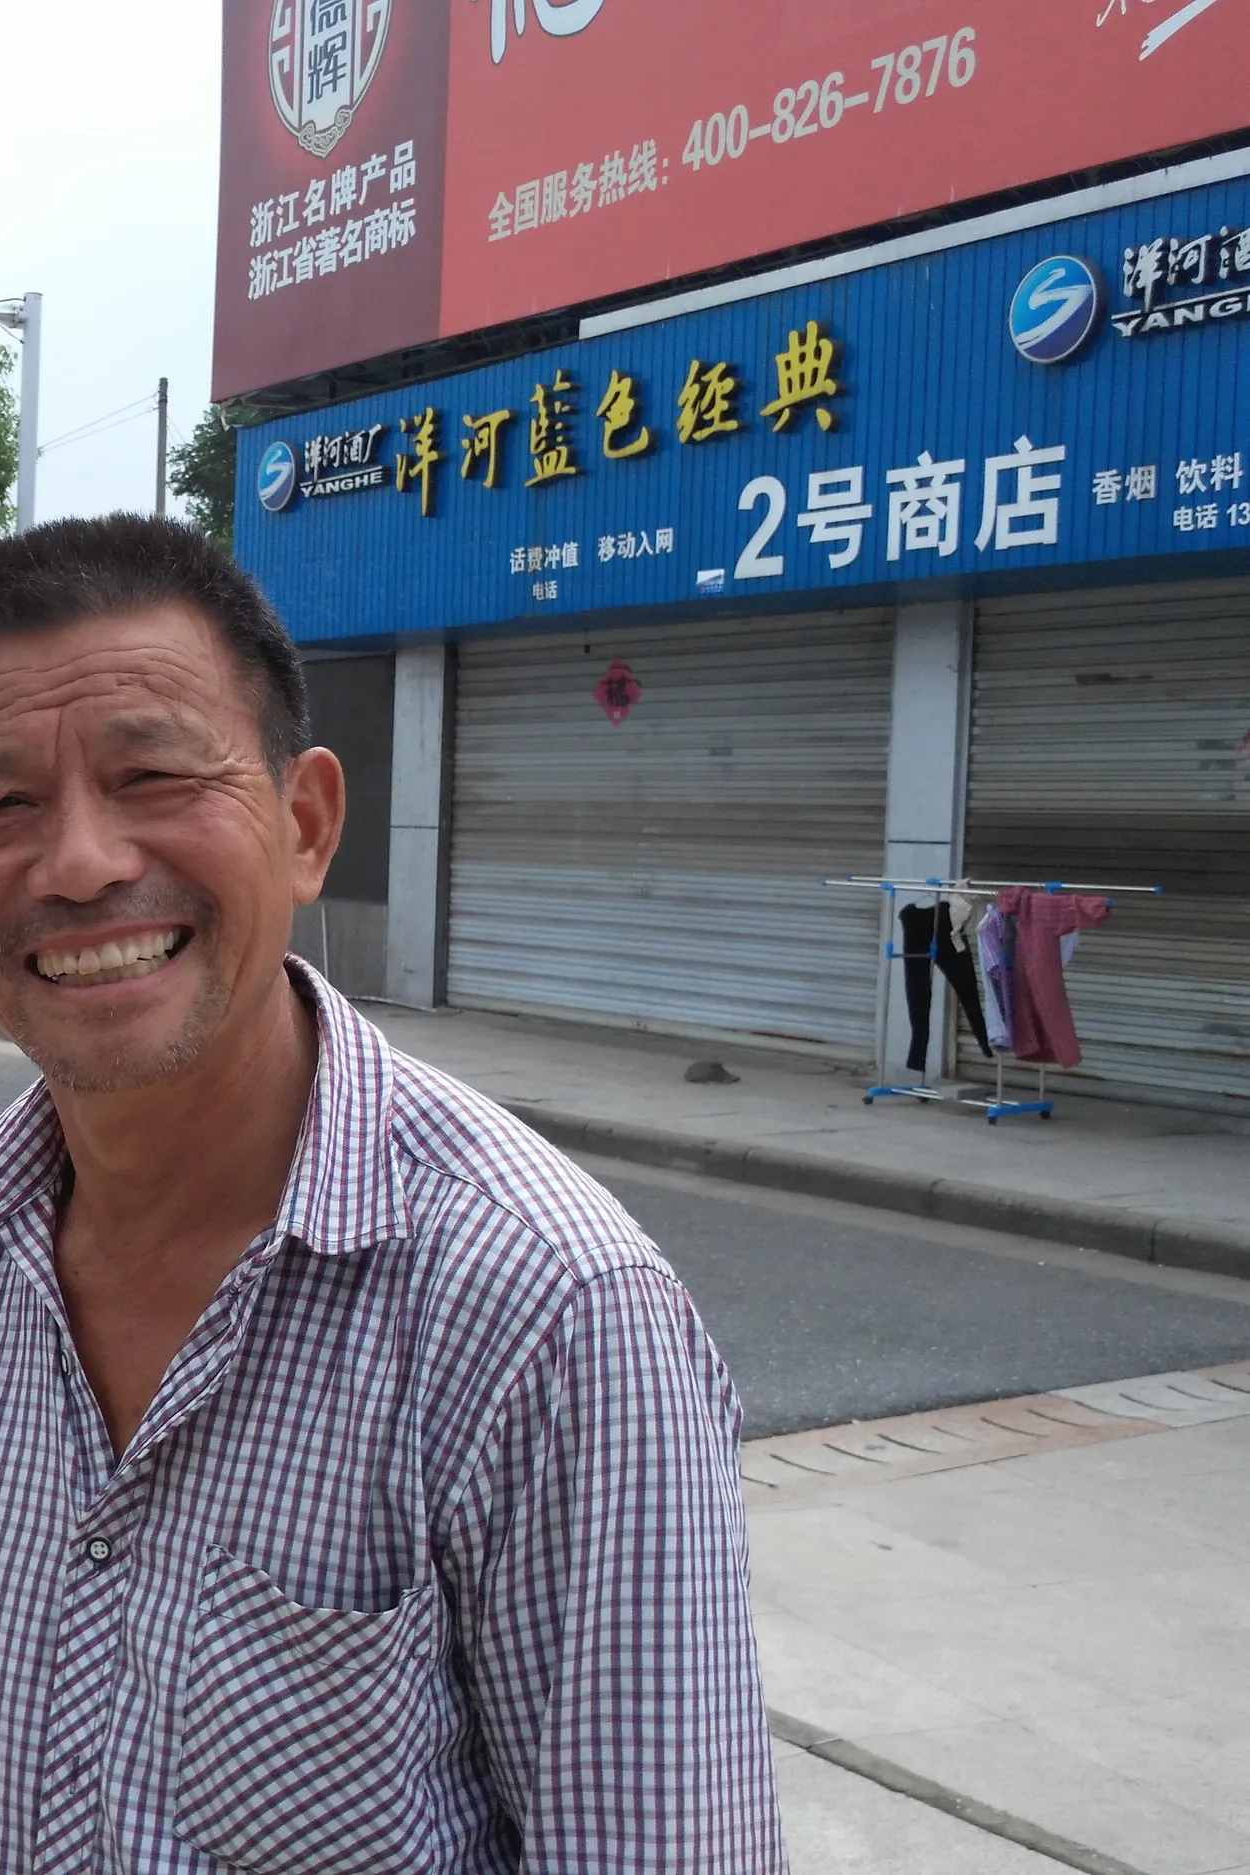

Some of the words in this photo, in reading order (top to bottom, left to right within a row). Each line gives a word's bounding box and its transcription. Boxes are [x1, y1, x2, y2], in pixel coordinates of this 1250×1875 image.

[488, 139, 669, 242] 全国服务热线：
[682, 27, 976, 171] 400-826-7876
[250, 140, 416, 248] 浙江名牌产品
[248, 198, 416, 300] 浙江省著名商标
[1111, 294, 1250, 337] YANG
[305, 424, 382, 482] 洋河酒厂
[1092, 465, 1156, 505] 香烟
[1175, 452, 1243, 494] 饮料
[301, 471, 382, 498] YANGHE
[733, 434, 1065, 579] 2号商店
[1173, 503, 1218, 531] 电话
[510, 541, 579, 574] 话费冲值
[598, 527, 674, 562] 移动入网
[533, 580, 558, 600] 电话
